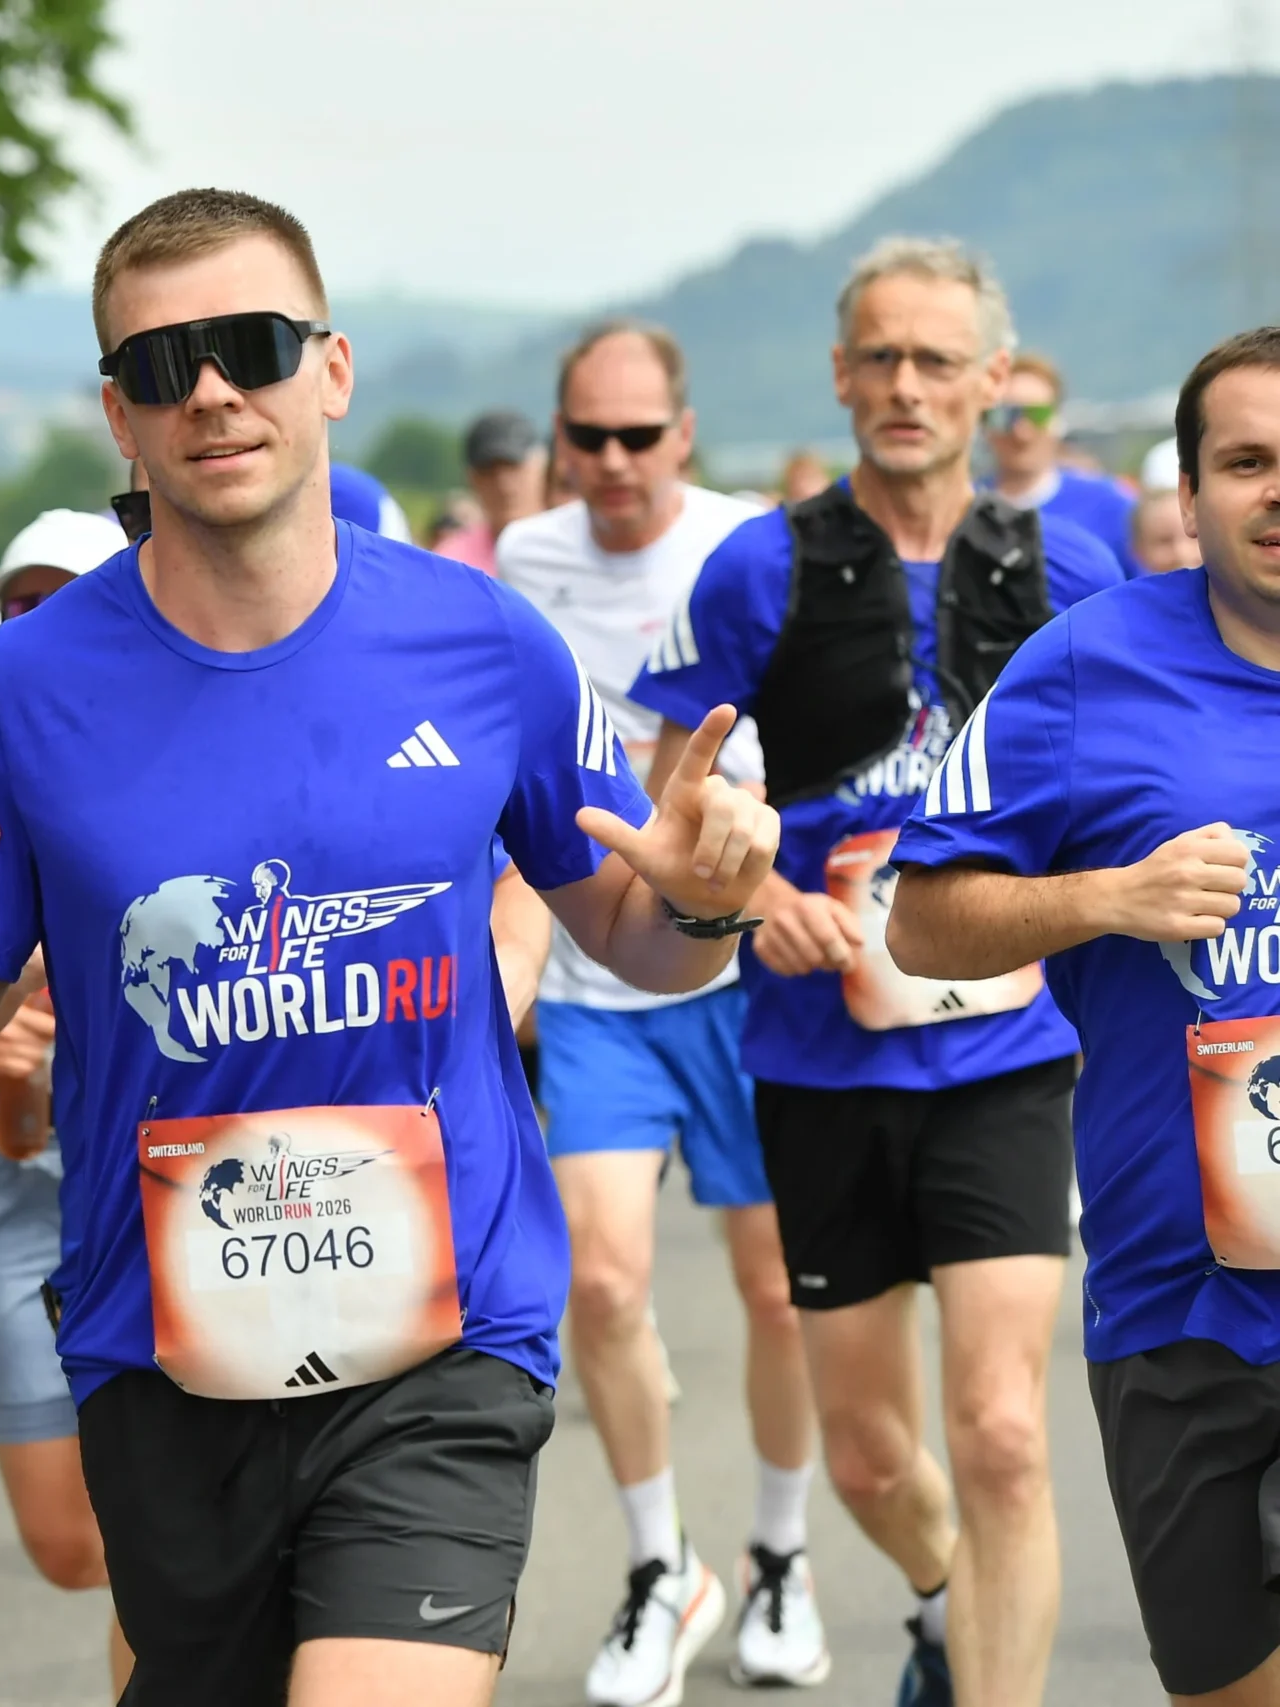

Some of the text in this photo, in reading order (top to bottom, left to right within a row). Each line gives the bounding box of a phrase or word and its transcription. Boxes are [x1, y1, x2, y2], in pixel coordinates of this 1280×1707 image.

[1248, 897, 1277, 910] FOR
[223, 896, 369, 944] WINGS
[219, 934, 330, 976] FOR LIFE
[1196, 1040, 1255, 1056] SWITZERLAND
[147, 1142, 206, 1158] SWITZERLAND
[250, 1156, 339, 1182] WINGS
[247, 1179, 317, 1201] FOR LIFE
[316, 1198, 352, 1218] 2026
[221, 1226, 375, 1279] 67046
